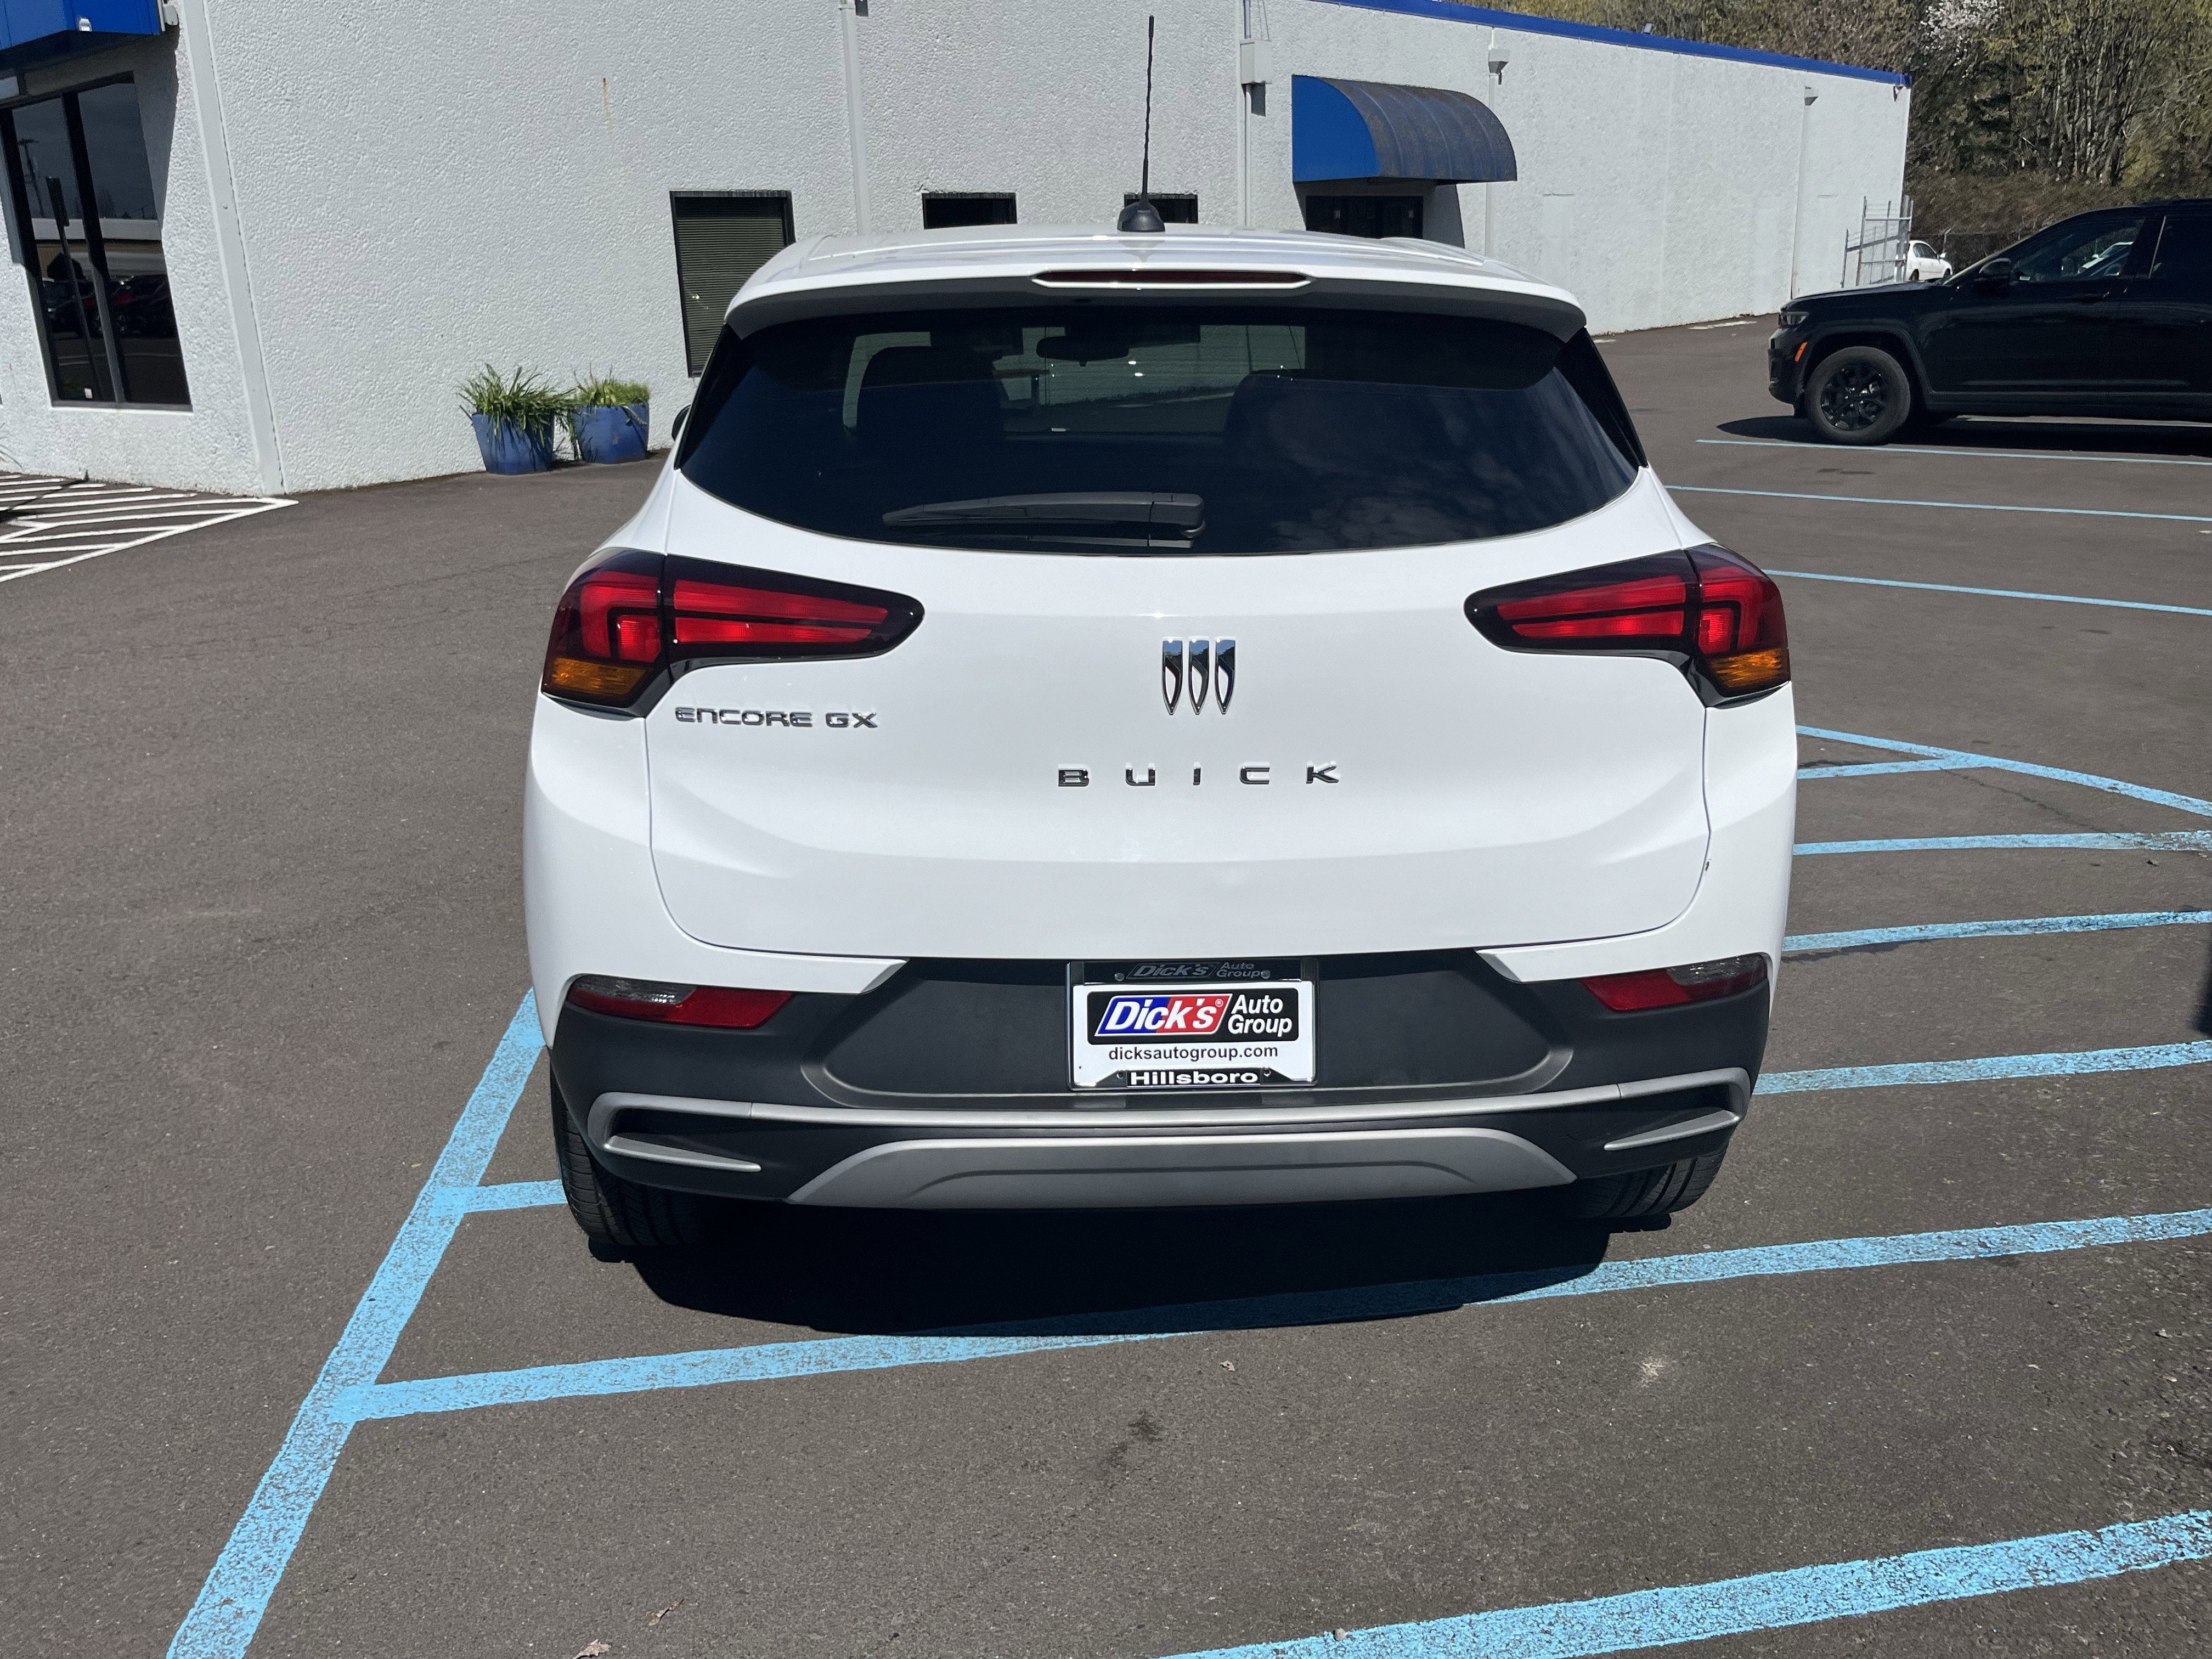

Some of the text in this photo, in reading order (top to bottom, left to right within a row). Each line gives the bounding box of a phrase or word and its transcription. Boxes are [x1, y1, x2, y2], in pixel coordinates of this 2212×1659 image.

[825, 712, 879, 728] GX
[1058, 762, 1340, 786] BUICK
[1132, 963, 1210, 978] Dick's
[1216, 969, 1261, 978] Group
[1218, 962, 1255, 970] Auto
[1231, 994, 1283, 1014] Auto
[1104, 999, 1217, 1030] Dick's
[1227, 1015, 1293, 1037] Group
[1108, 1046, 1278, 1062] dicksautogroup.com
[1129, 1070, 1259, 1085] Hillsboro
